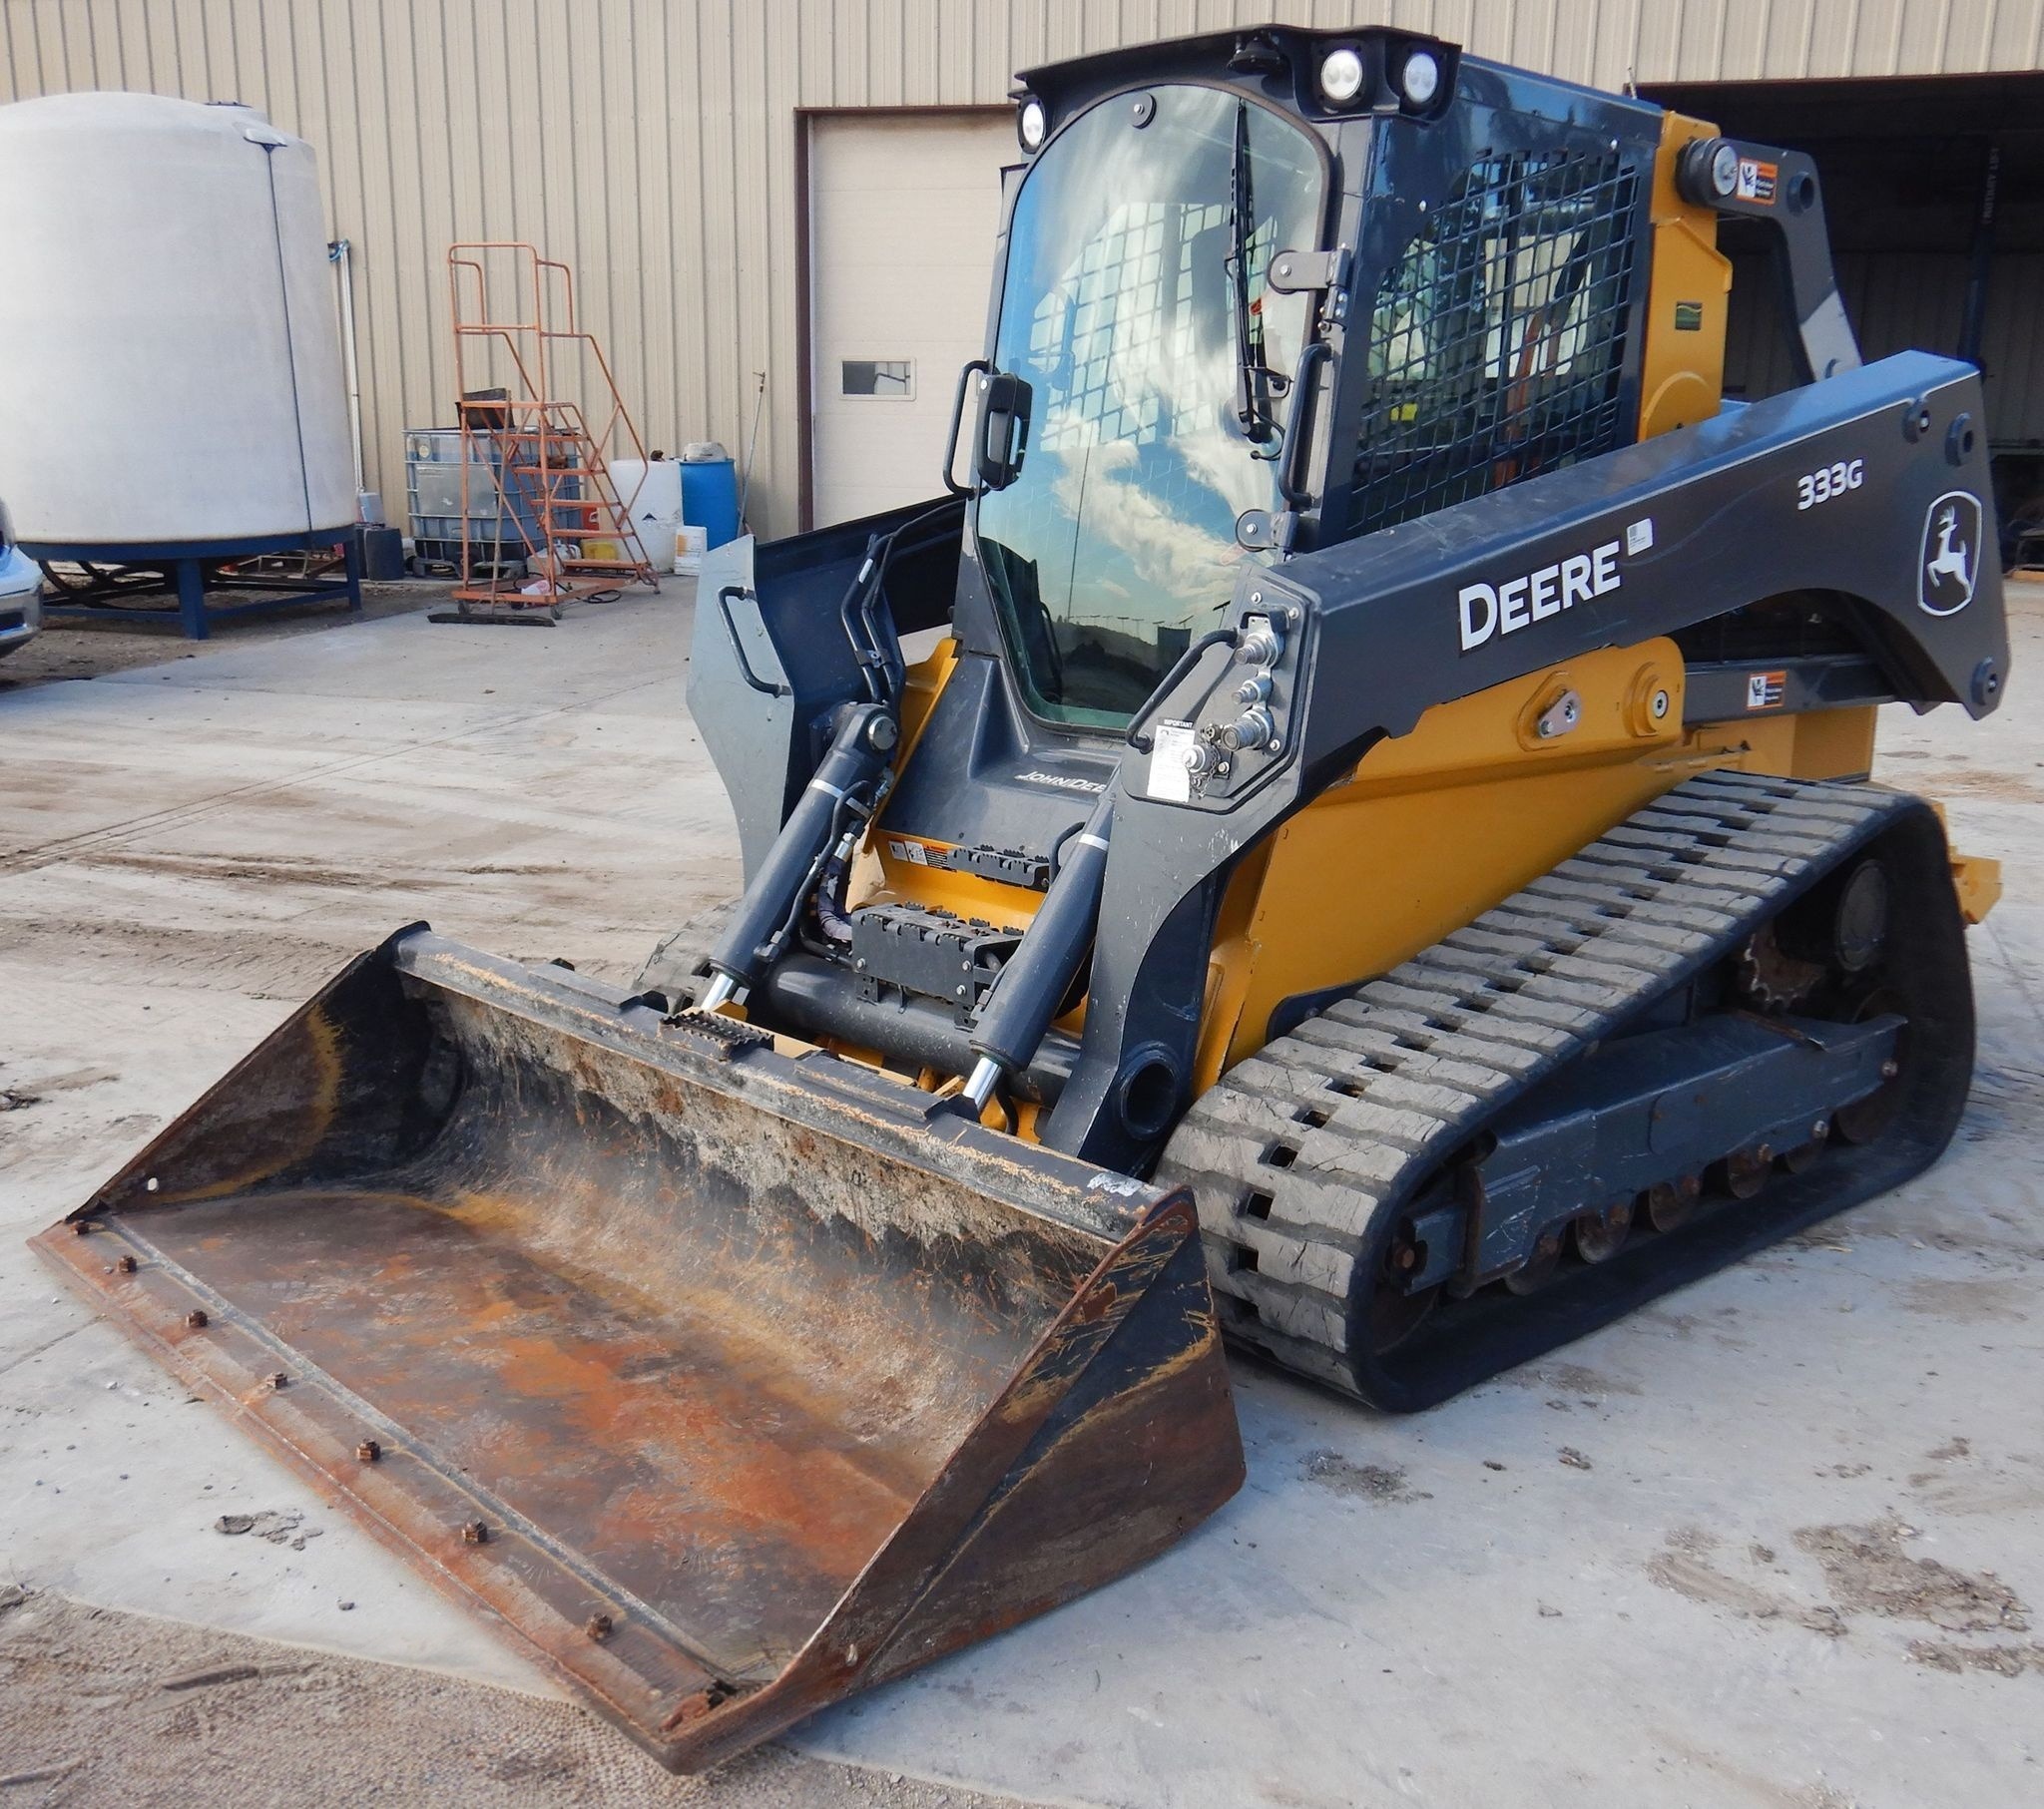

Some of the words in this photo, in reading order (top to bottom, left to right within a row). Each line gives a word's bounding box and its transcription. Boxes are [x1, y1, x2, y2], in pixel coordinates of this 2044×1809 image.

[1796, 459, 1862, 510] 333G
[1459, 540, 1621, 651] DEERE
[1164, 718, 1194, 728] IMPORTANT
[1015, 771, 1070, 787] JOHN
[1066, 778, 1108, 793] DEE
